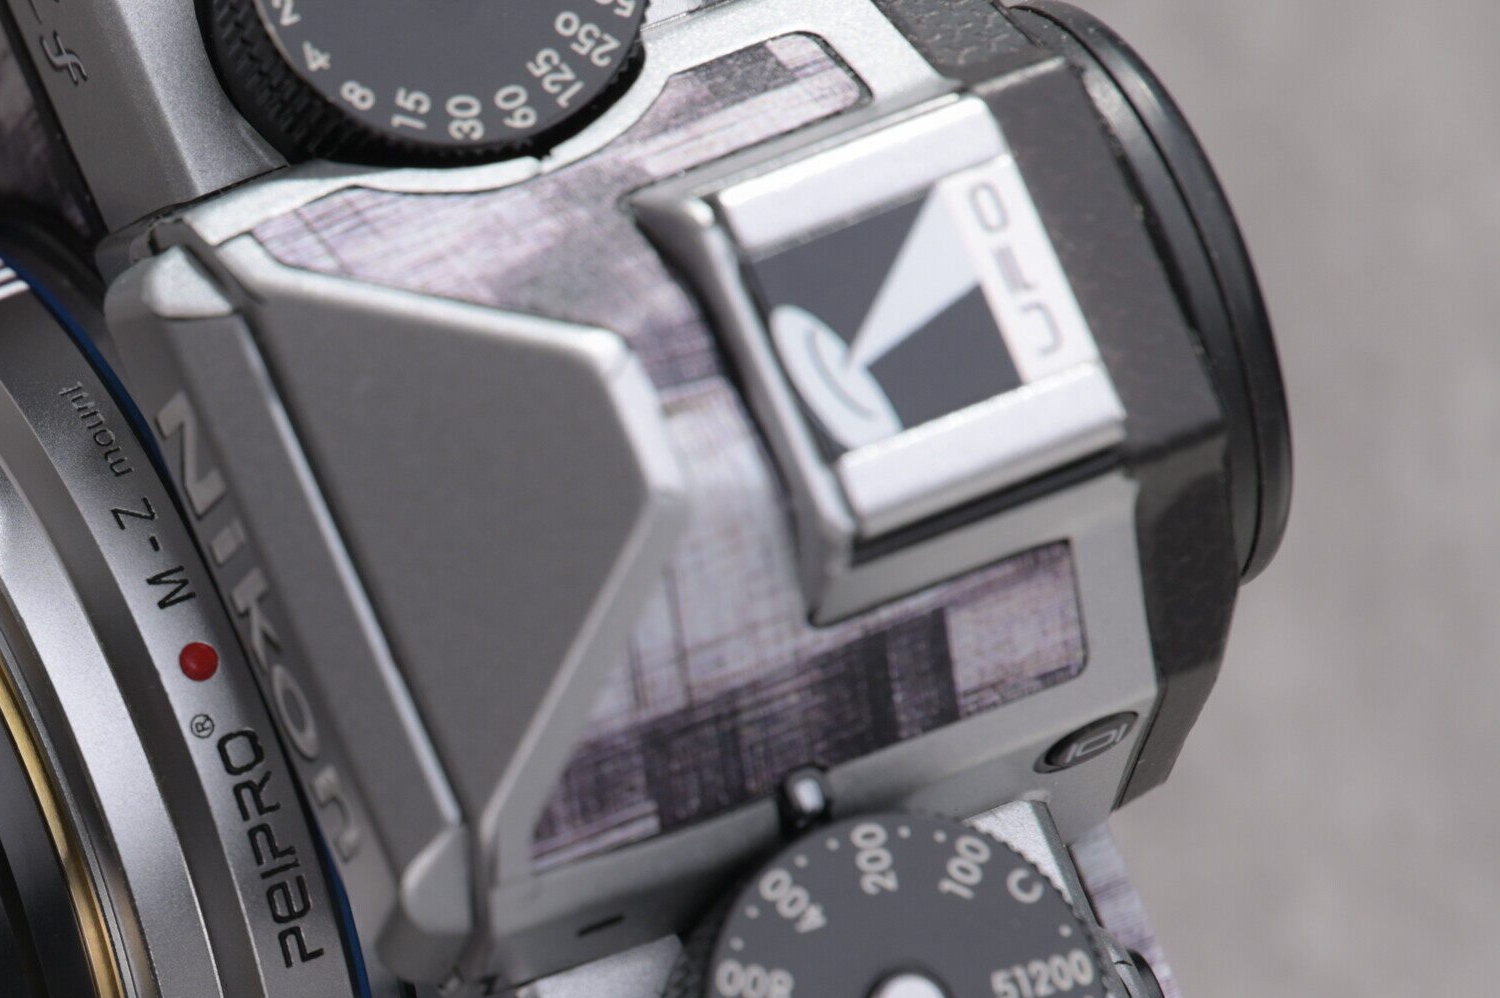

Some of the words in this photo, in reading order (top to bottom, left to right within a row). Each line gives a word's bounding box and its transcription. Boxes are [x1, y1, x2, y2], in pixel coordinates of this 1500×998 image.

[303, 40, 331, 71] 4
[554, 10, 621, 67] 250
[340, 80, 375, 111] 8
[494, 84, 537, 129] 60
[526, 48, 584, 109] 125
[390, 87, 432, 130] 15
[445, 94, 485, 141] 30
[57, 382, 134, 477] mount
[154, 391, 361, 864] Nikon
[850, 822, 898, 895] 200
[938, 835, 991, 900] 100
[1006, 868, 1044, 904] C
[759, 868, 828, 934] 400
